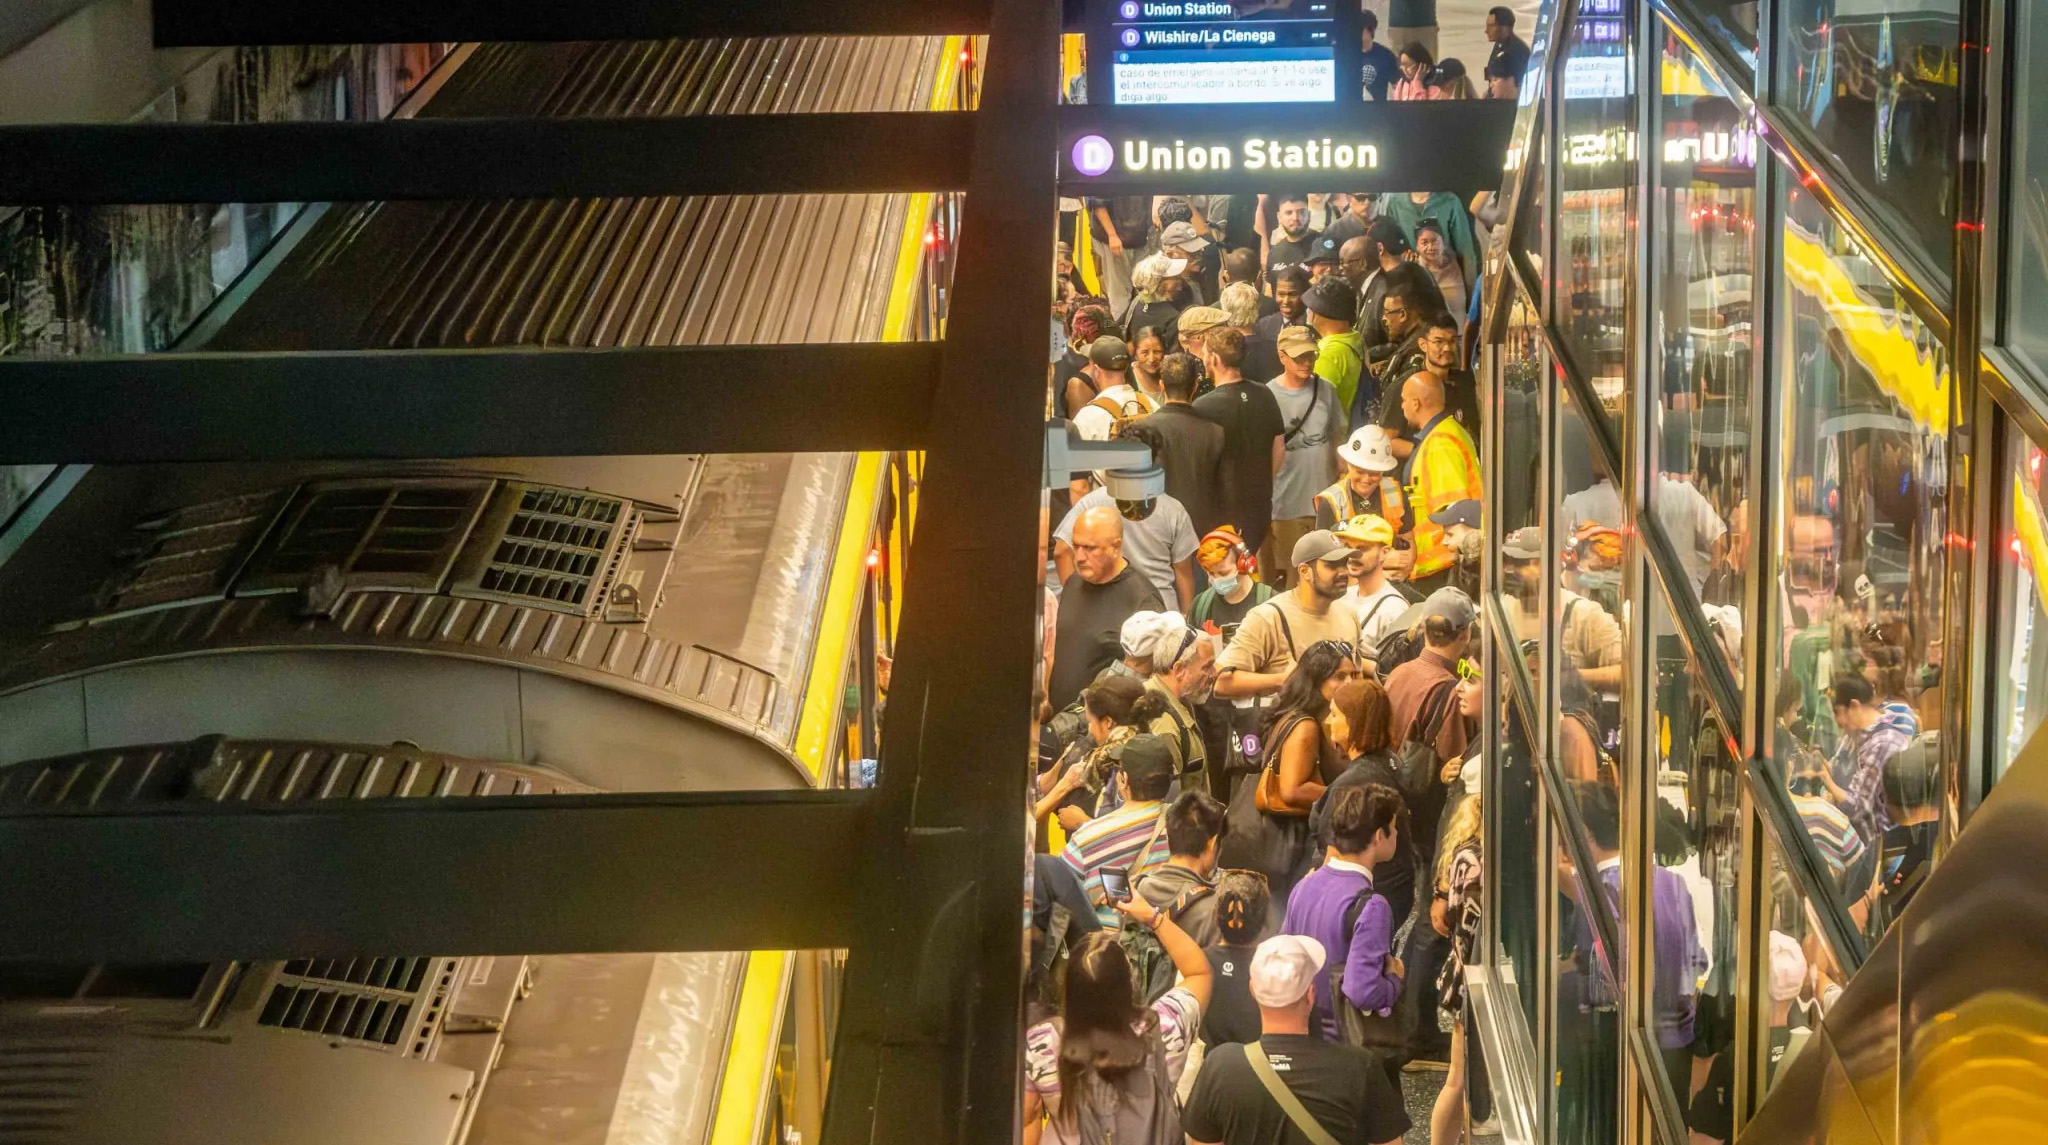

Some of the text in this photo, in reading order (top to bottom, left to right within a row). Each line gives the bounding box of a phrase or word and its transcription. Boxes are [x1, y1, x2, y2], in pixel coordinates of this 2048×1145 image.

[1144, 4, 1182, 16] Union
[1185, 2, 1232, 15] Station
[1145, 30, 1220, 44] Wilshire/La
[1223, 29, 1276, 43] Cienega
[1120, 69, 1144, 78] caso
[1147, 68, 1160, 78] de
[1120, 80, 1130, 90] el
[1121, 92, 1168, 102] diga algo
[1083, 138, 1378, 170] D Union Station
